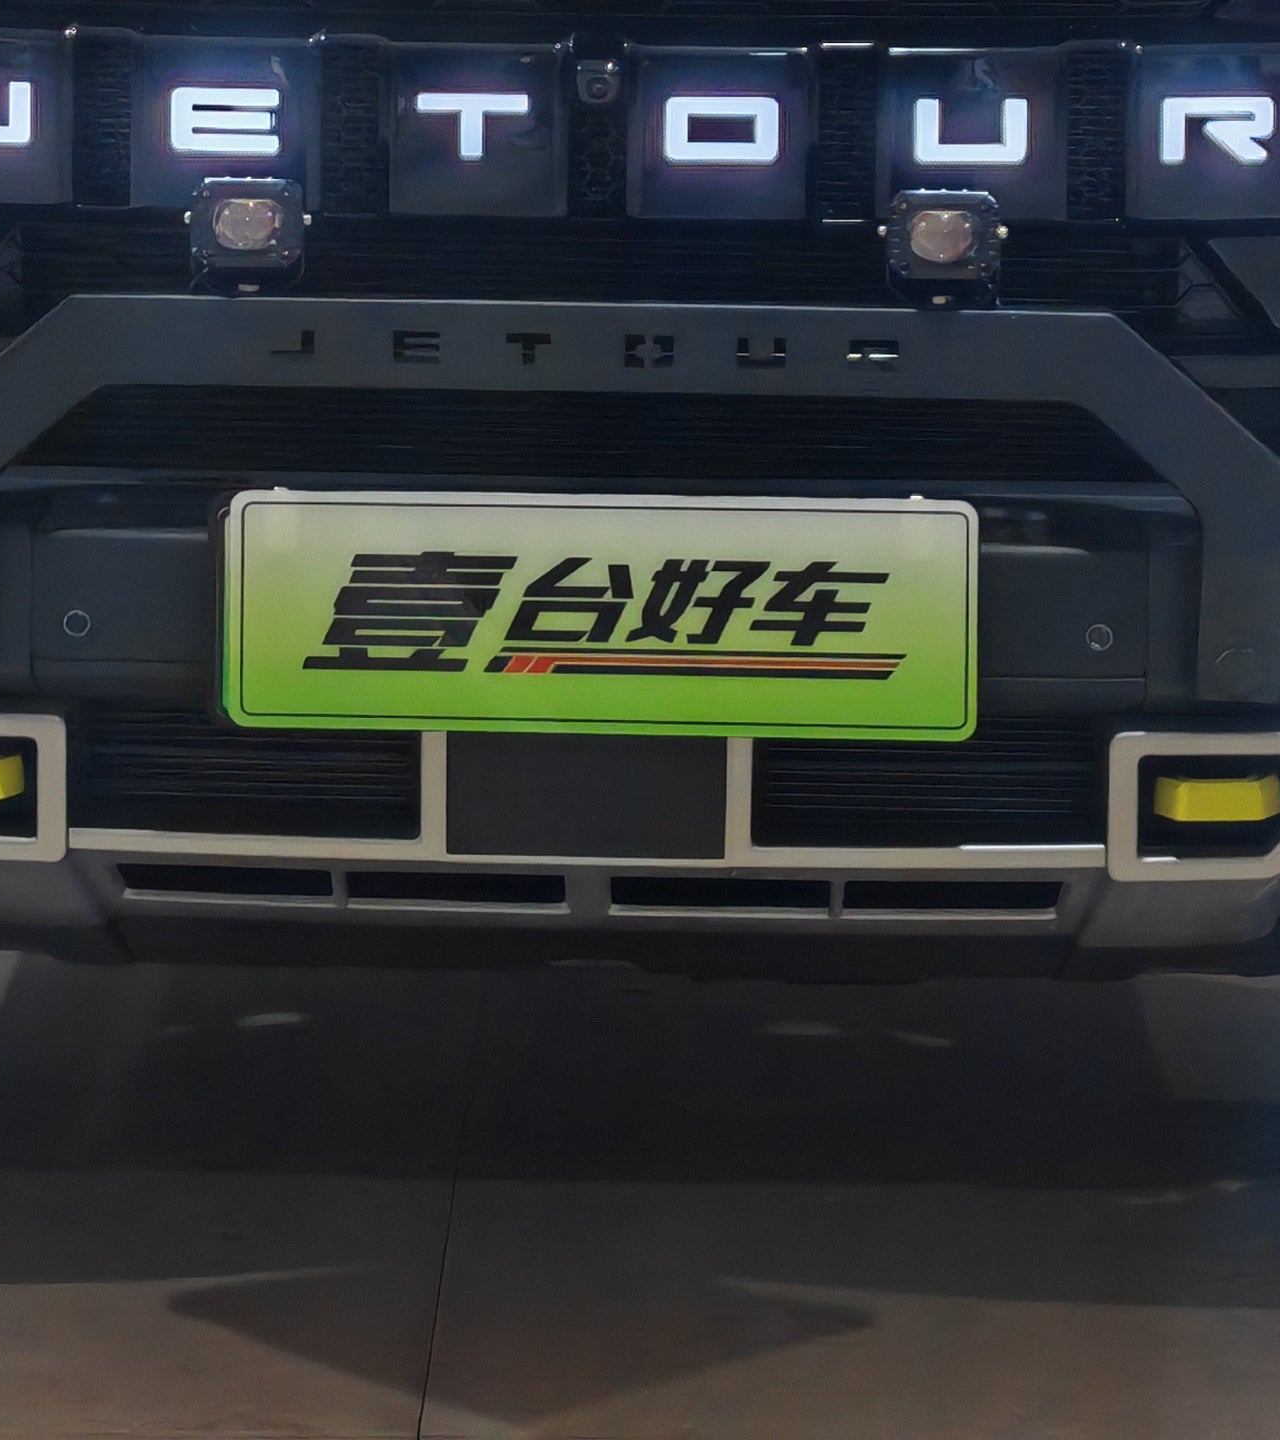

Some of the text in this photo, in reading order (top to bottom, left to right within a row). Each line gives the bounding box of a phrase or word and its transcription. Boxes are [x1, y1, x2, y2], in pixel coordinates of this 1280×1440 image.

[270, 329, 901, 372] JETOUR
[301, 550, 891, 672] 壹台好车
